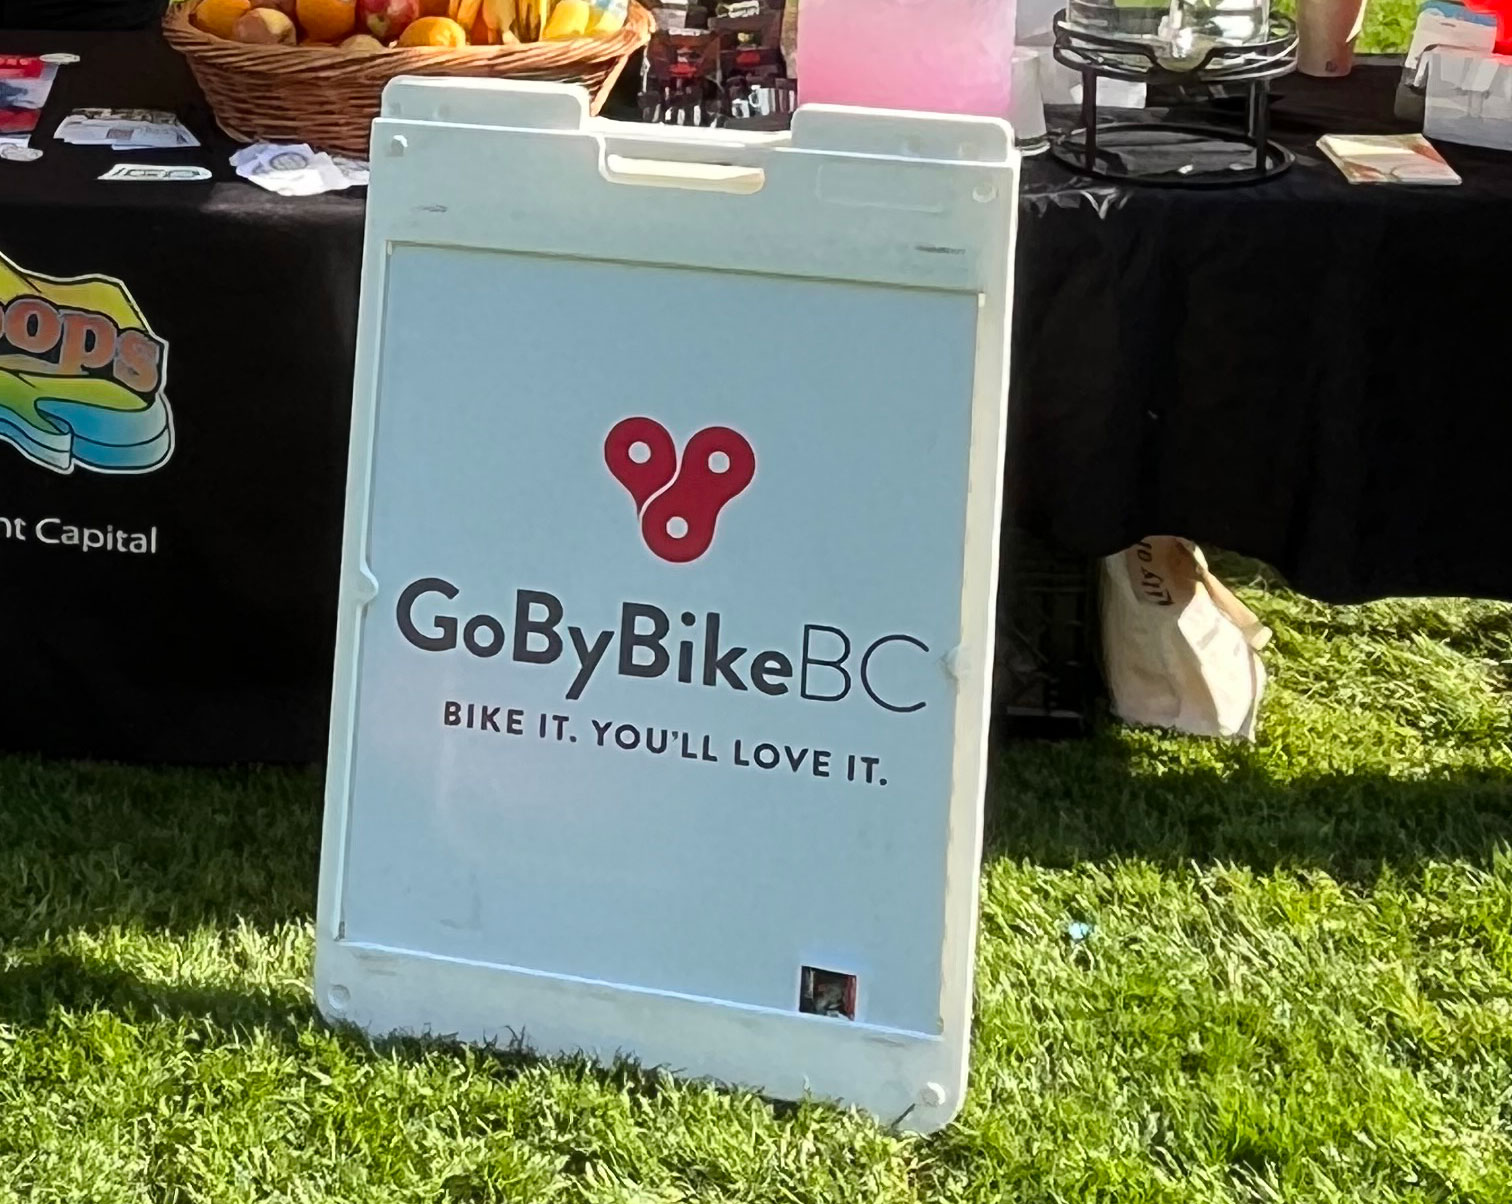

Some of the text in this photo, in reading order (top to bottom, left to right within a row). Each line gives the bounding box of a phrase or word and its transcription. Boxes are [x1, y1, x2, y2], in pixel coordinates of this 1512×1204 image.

[35, 518, 159, 554] Capital
[395, 576, 930, 714] GoByBikeBC
[443, 700, 889, 787] BIKE IT. YOU'LL LOVE IT.
